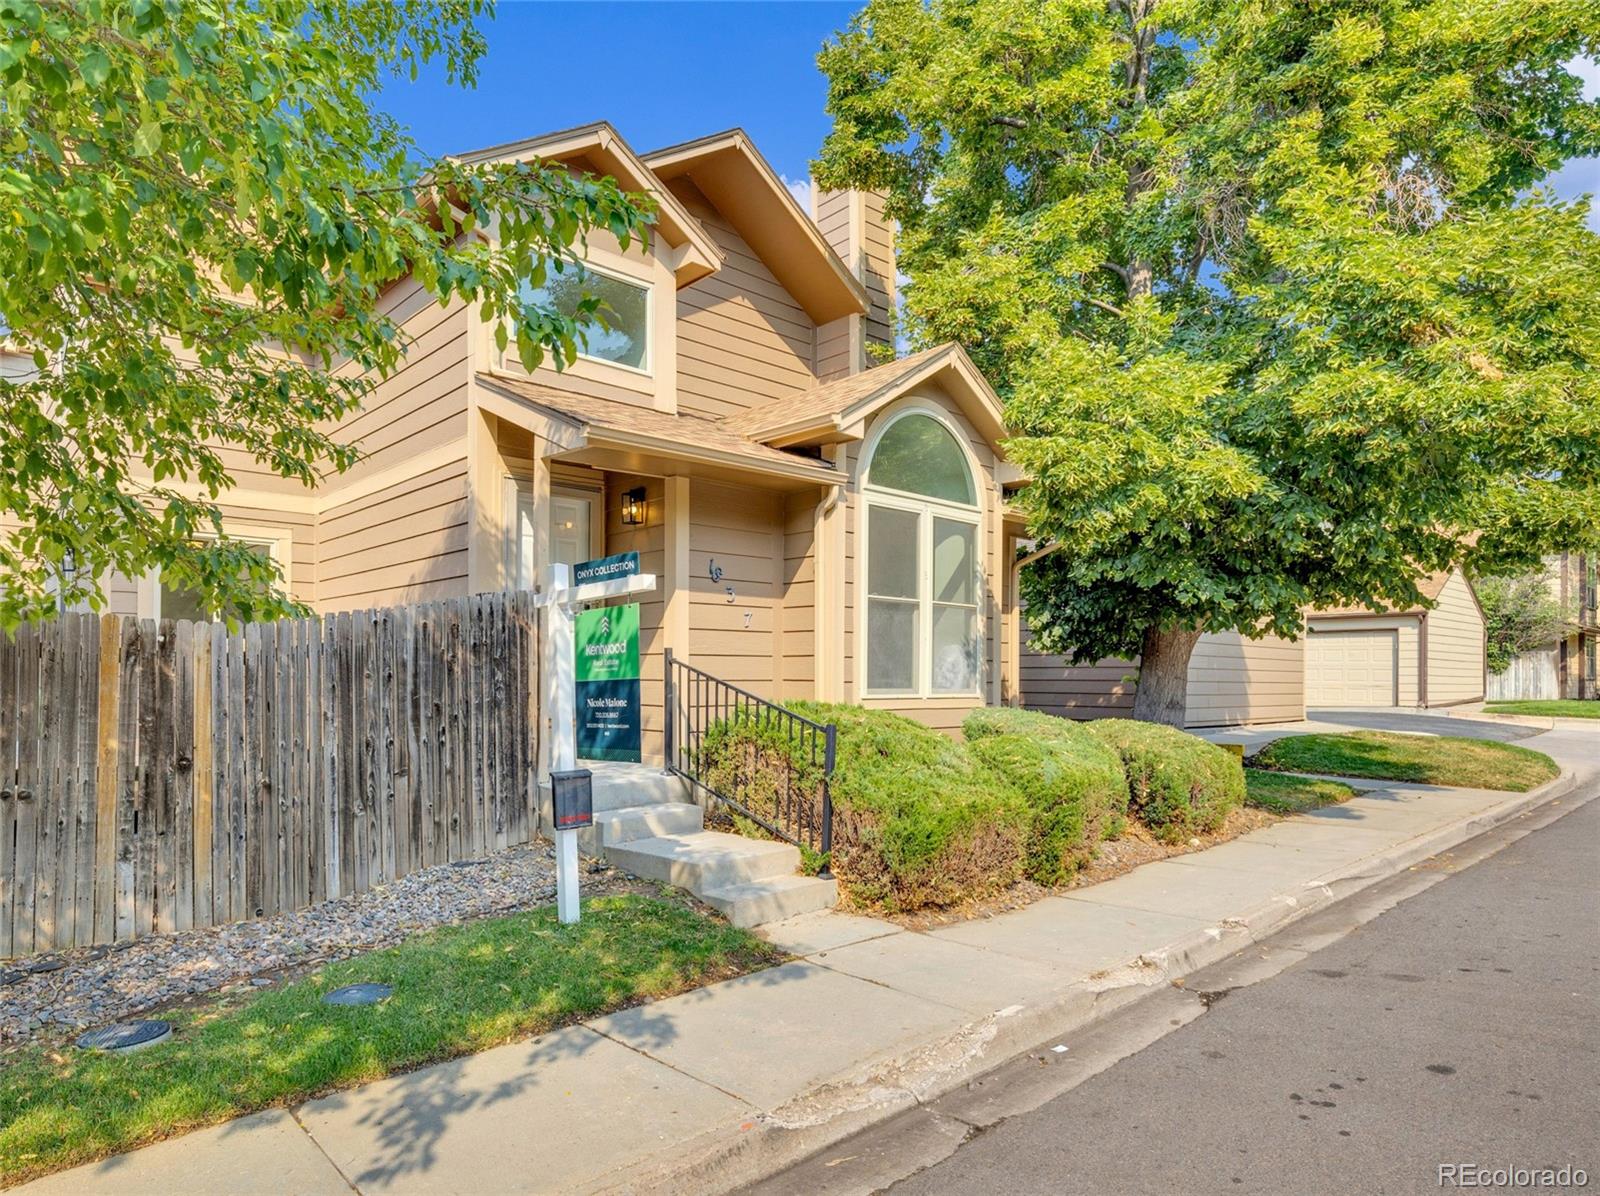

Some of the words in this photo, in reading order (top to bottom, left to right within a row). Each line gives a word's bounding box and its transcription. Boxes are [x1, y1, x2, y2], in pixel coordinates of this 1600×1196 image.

[577, 569, 594, 579] ONYX
[594, 560, 635, 575] COLLECTION
[585, 640, 627, 656] Kentwood
[587, 698, 605, 707] Nicole
[605, 698, 628, 707] Malone
